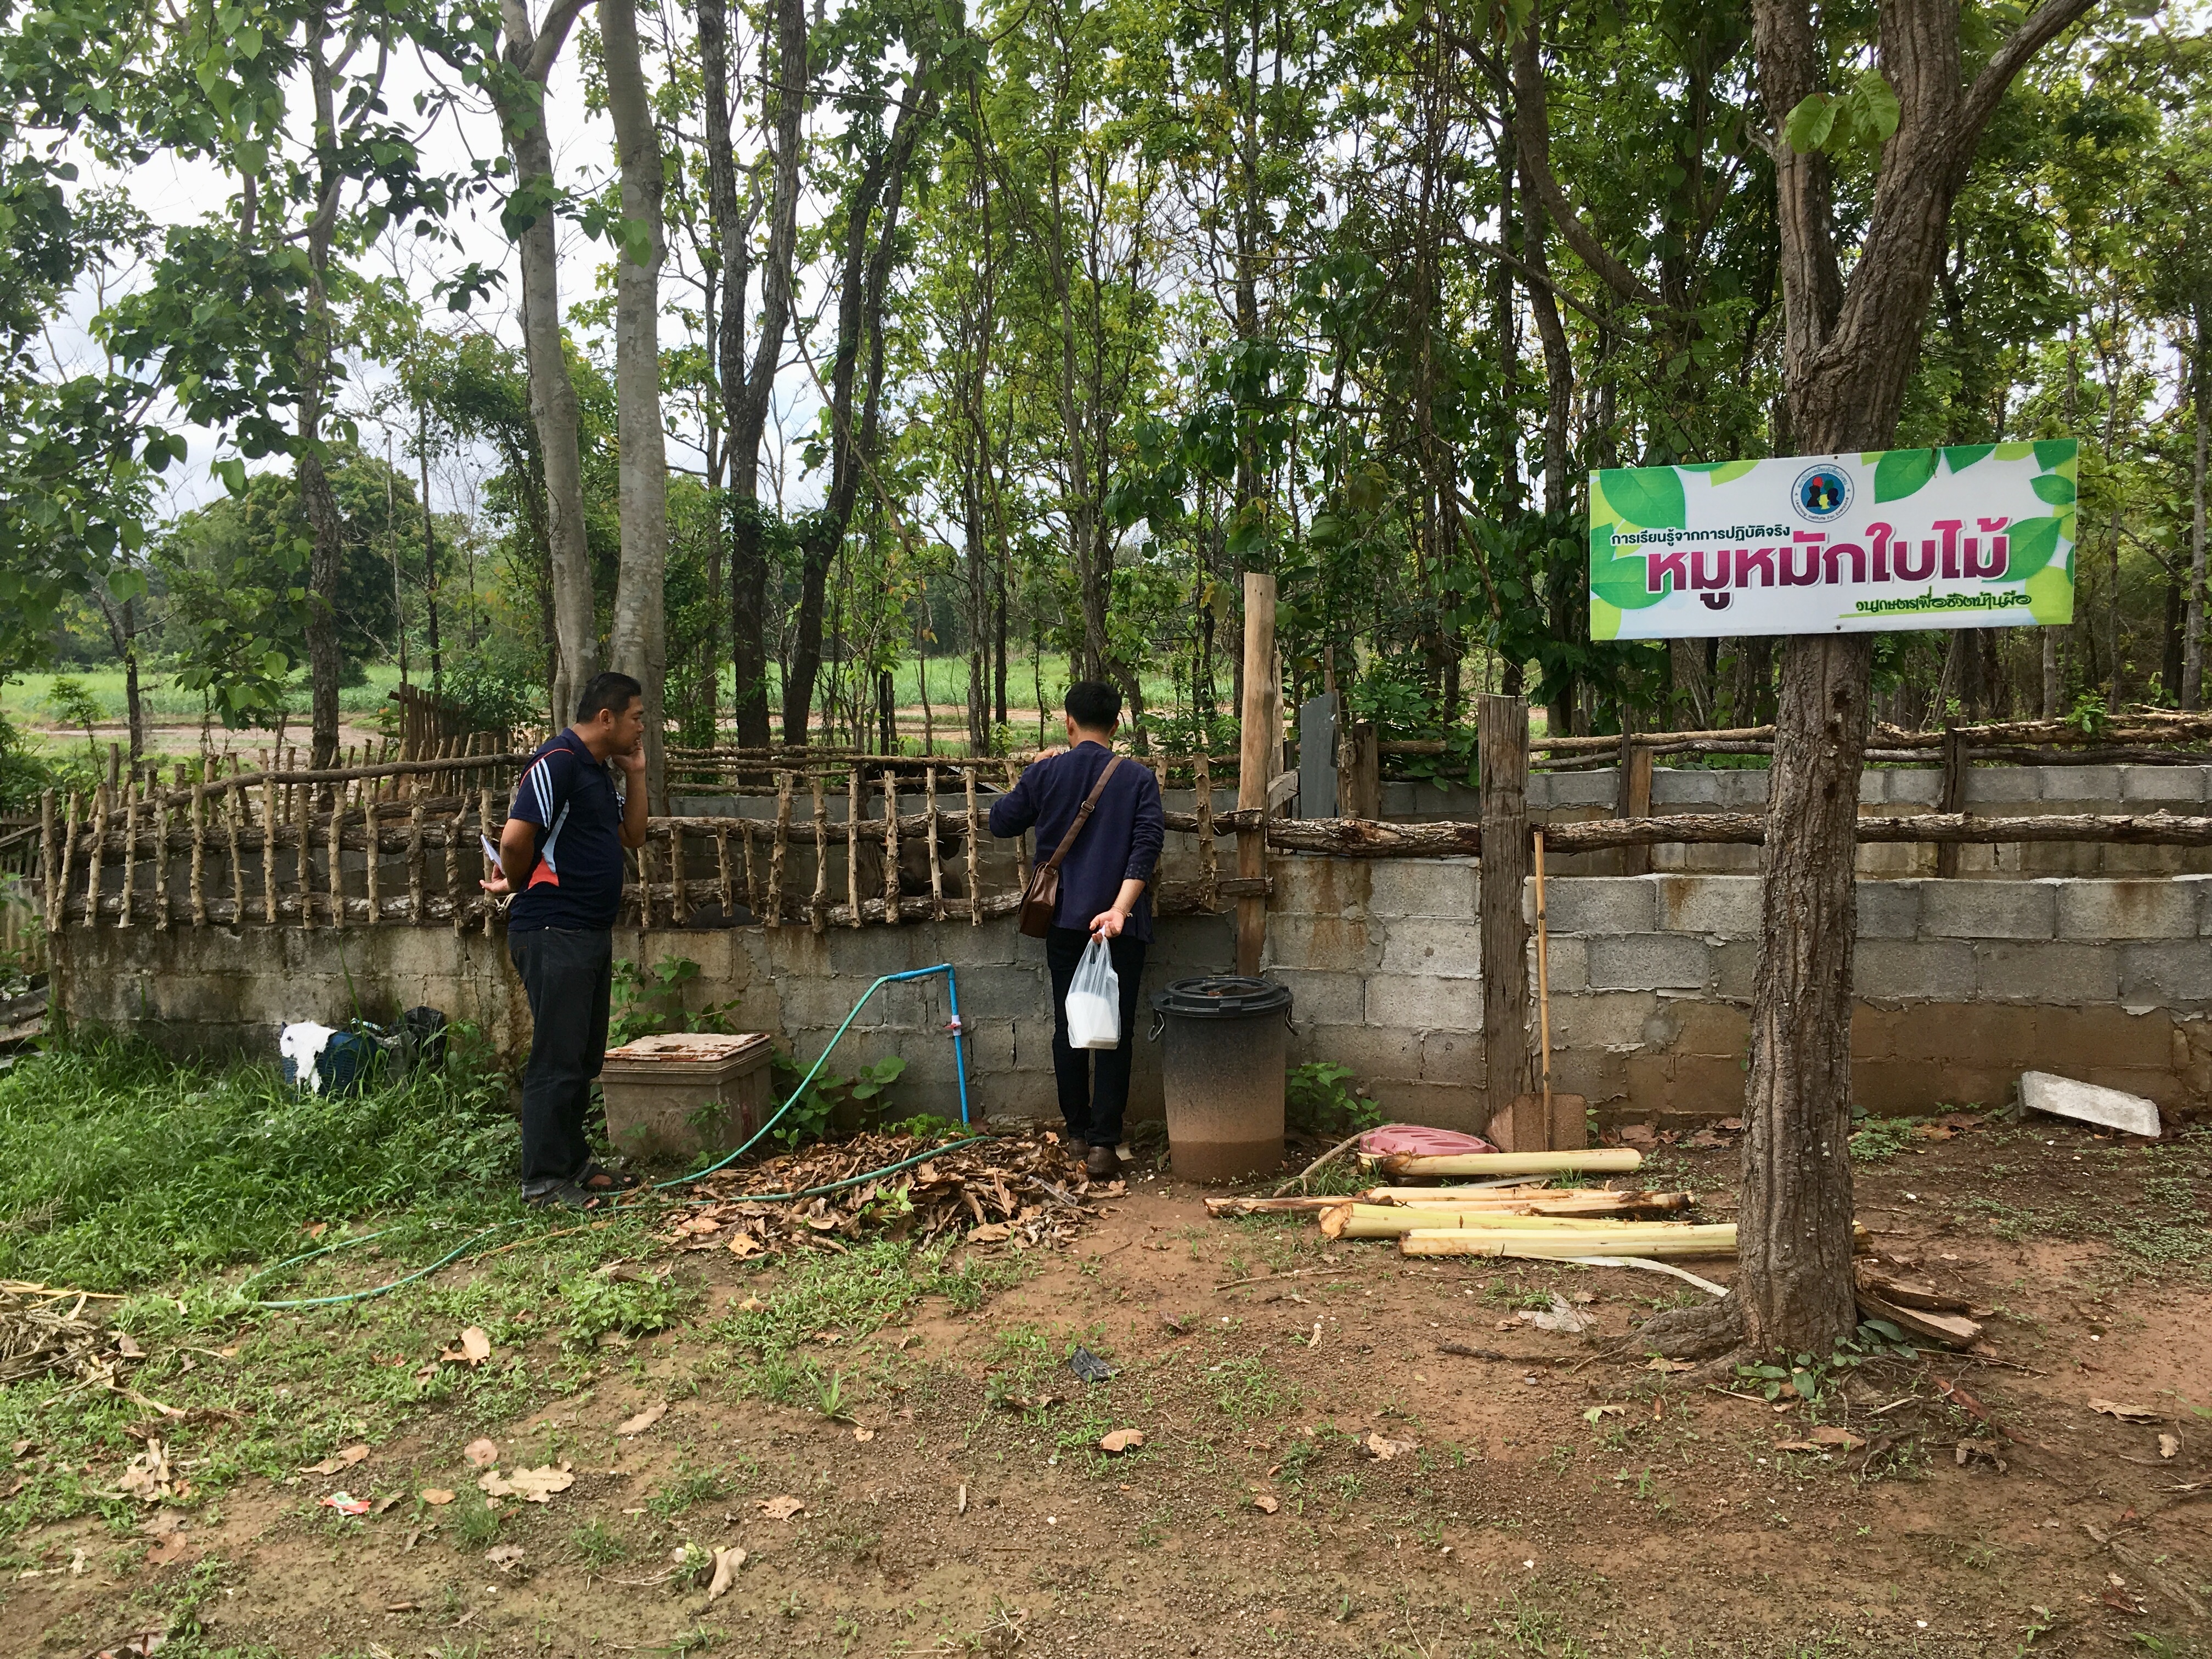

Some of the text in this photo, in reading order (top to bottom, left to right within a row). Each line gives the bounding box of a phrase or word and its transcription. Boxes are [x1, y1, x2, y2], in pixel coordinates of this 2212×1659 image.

[1795, 499, 1807, 517] Learning
[1836, 497, 1849, 516] Everyone
[1611, 524, 1790, 546] การเรียนรู้จากการปฏิบัติจริง
[1648, 517, 2010, 610] หมูหมักใบไม้
